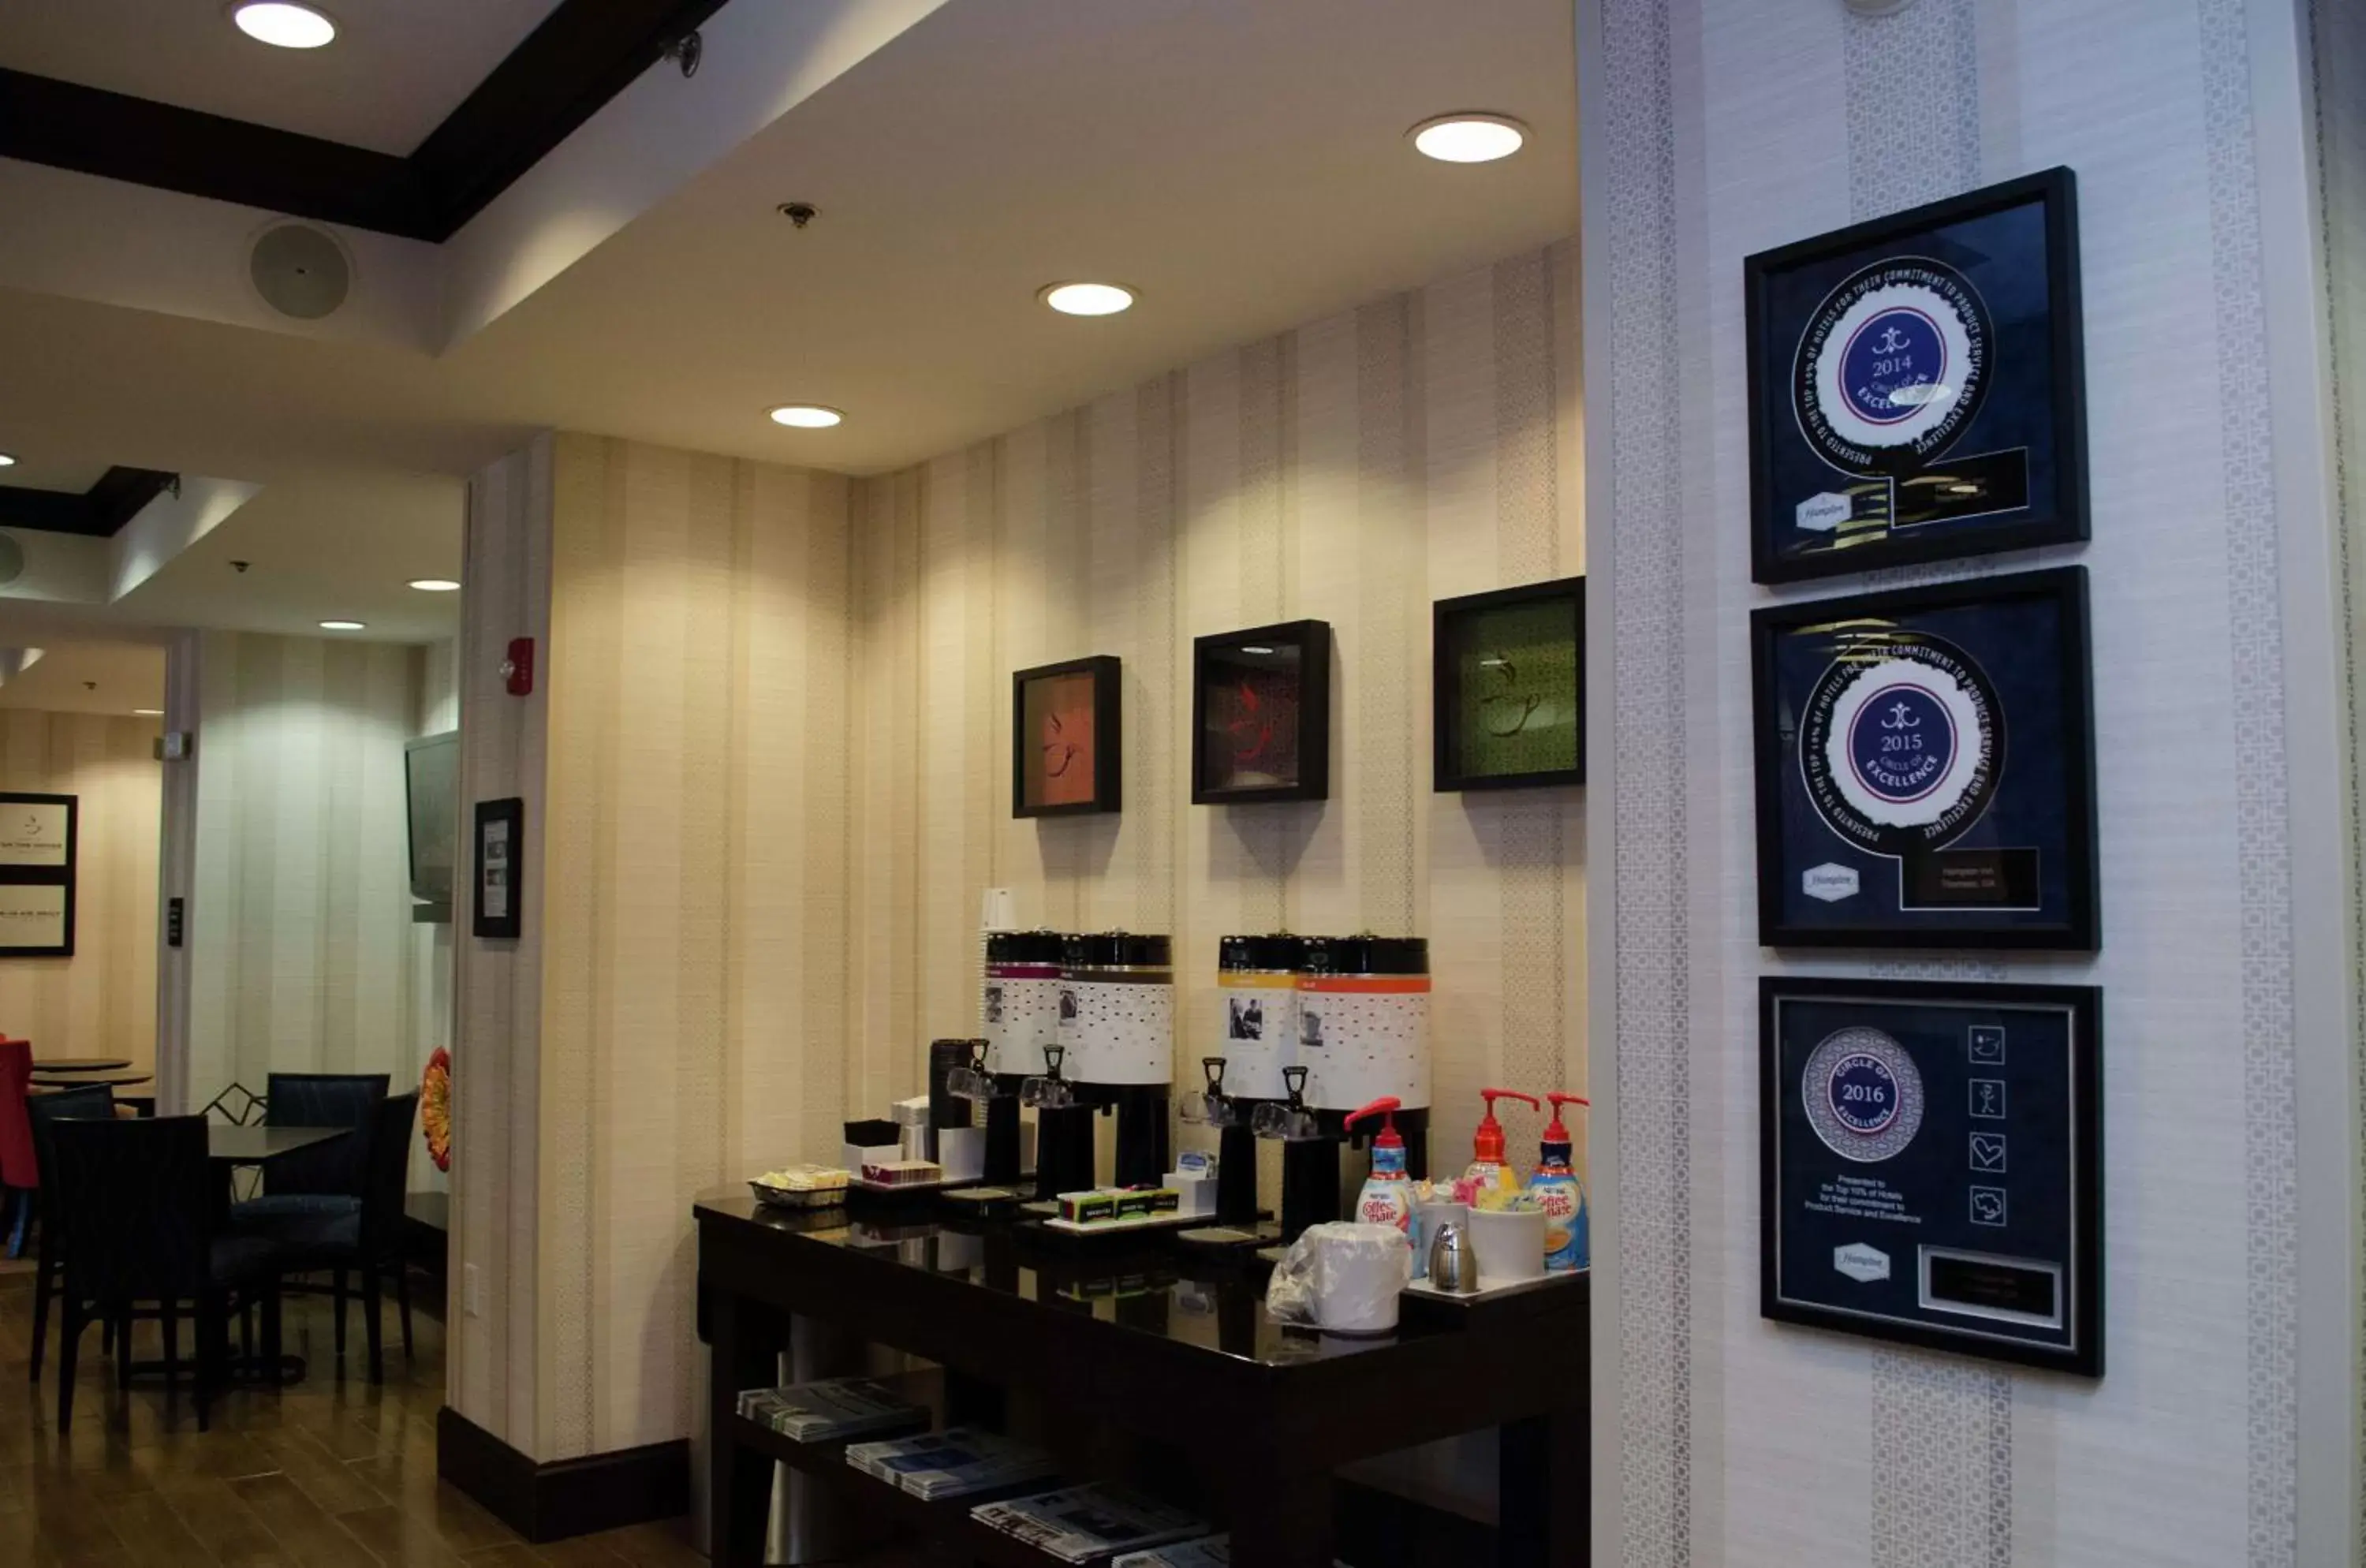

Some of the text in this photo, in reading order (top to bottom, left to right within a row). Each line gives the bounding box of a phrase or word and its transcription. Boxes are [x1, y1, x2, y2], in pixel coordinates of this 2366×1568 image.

[1883, 268, 1946, 288] COMMITMENT
[1813, 309, 1838, 344] HOTELS
[1953, 292, 1981, 334] PRODUCT
[1872, 354, 1913, 378] 2014
[1969, 337, 1984, 382] SERVICE
[1915, 405, 1965, 456] EXCELLENCE
[1891, 644, 1955, 671] COMMITMENT
[1953, 663, 1967, 681] TO
[1818, 677, 1844, 710] HOTELS
[1962, 676, 1991, 724] PRODUCT
[1880, 733, 1923, 752] 2015
[1865, 754, 1939, 788] EXCELLENCE
[1833, 807, 1880, 843] PRESENTED
[1923, 793, 1974, 840] EXCELLENCE
[1835, 1057, 1891, 1081] CIRCLE OF
[1842, 1084, 1886, 1103] 2016
[1837, 1104, 1891, 1128] EXCELLENCE
